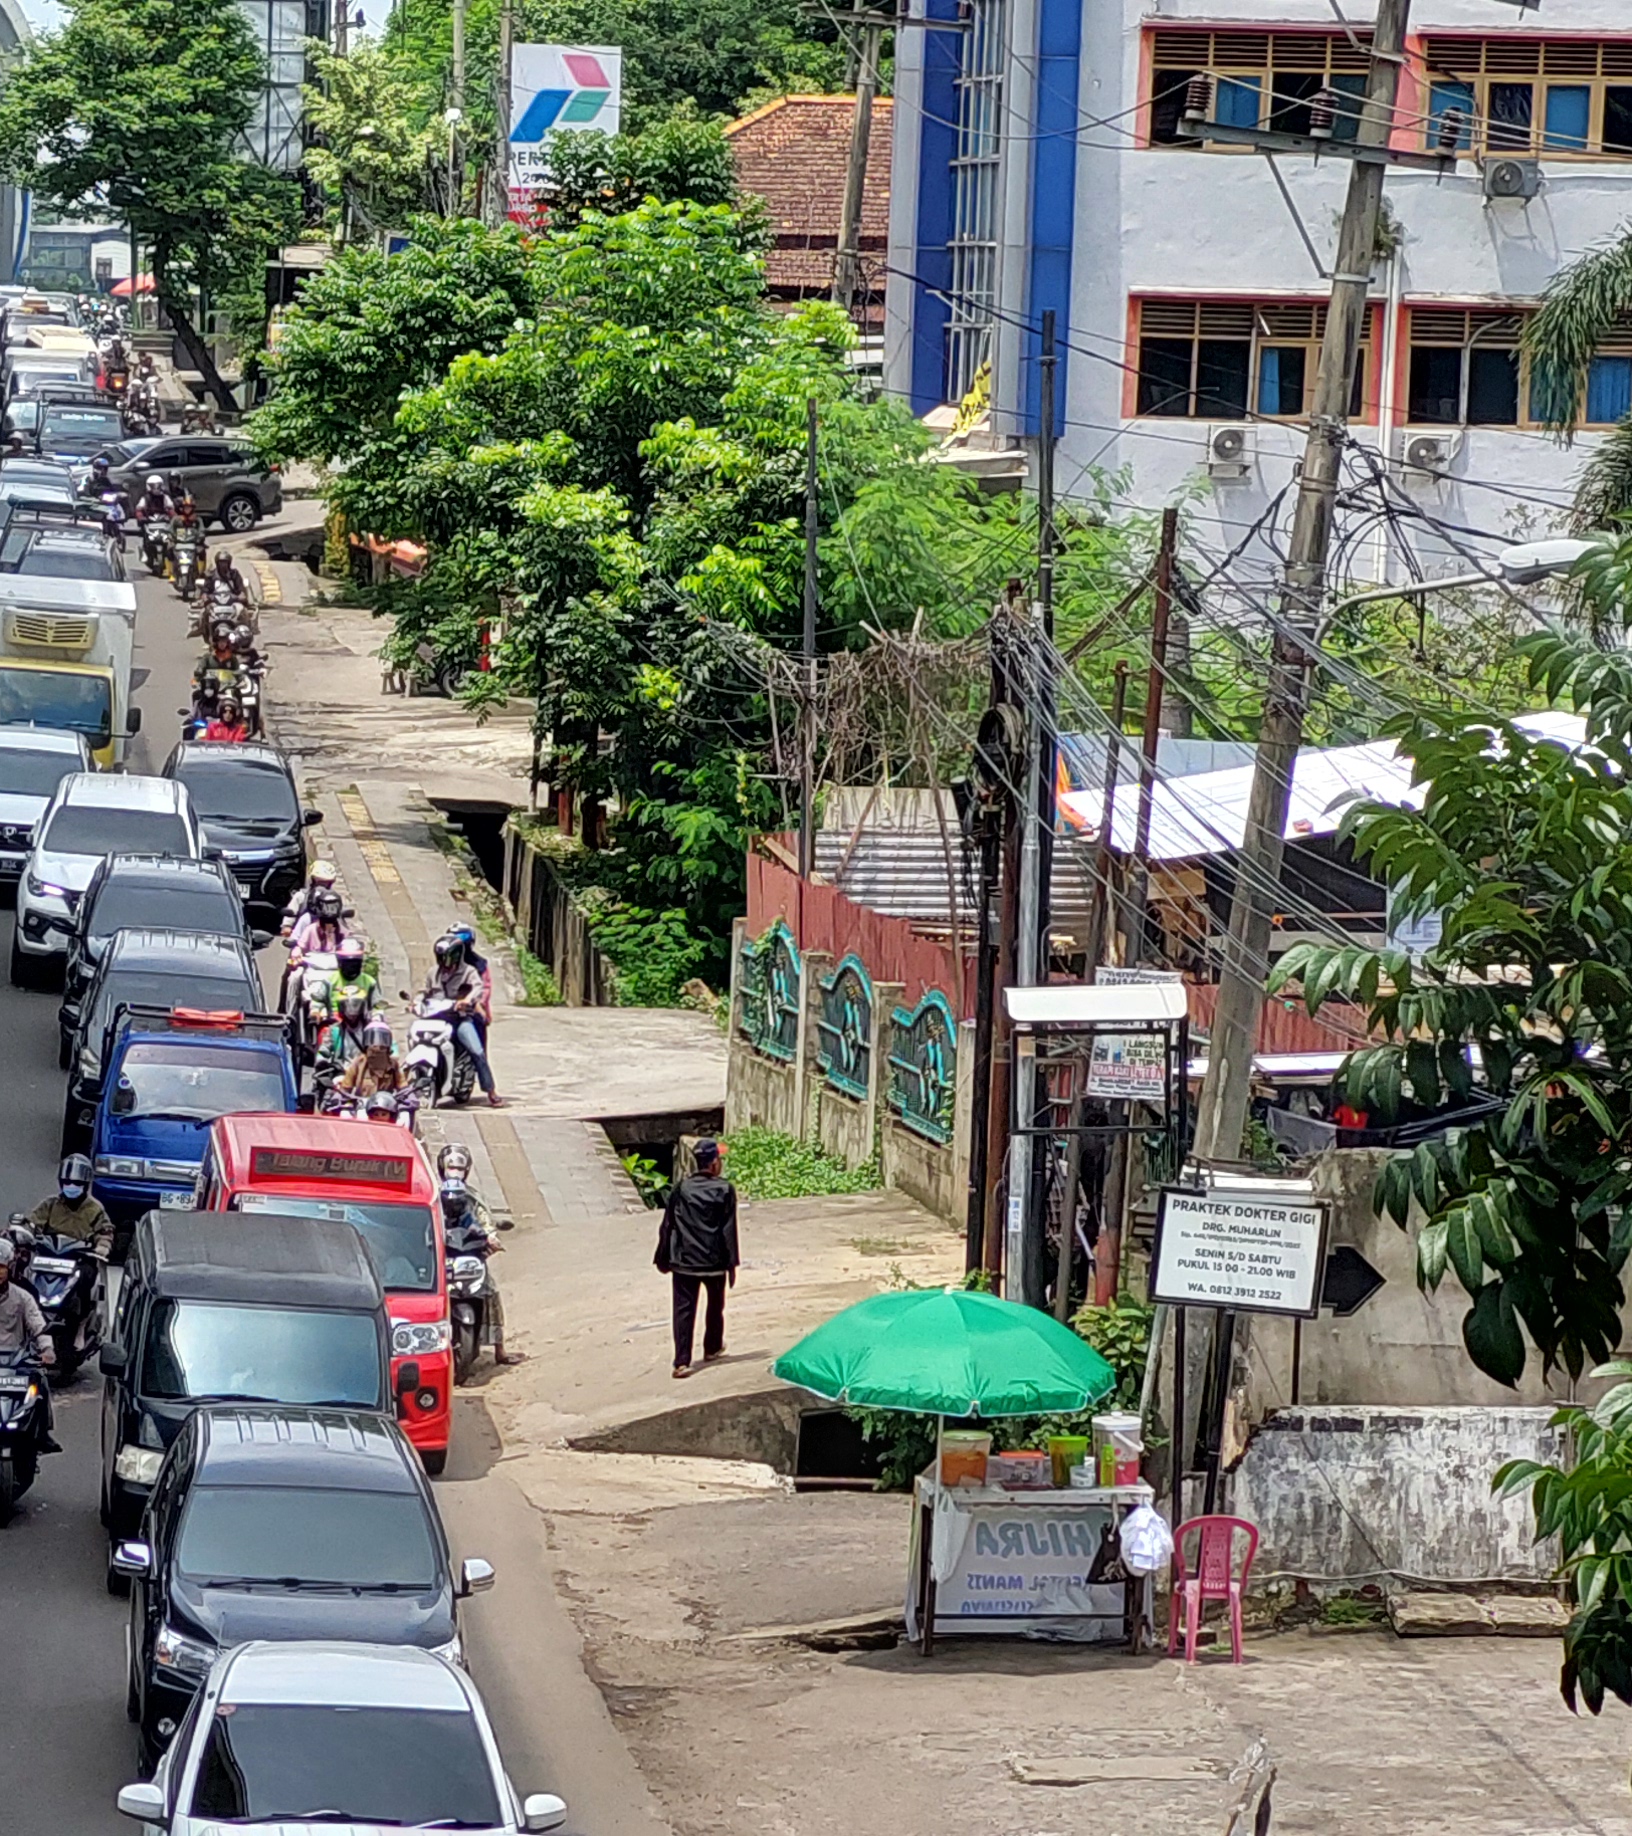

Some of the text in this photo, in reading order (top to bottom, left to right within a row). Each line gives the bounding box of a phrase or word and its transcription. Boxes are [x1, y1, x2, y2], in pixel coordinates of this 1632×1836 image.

[1172, 1199, 1316, 1225] PRAKTEK DOKTER GIGI
[1202, 1222, 1226, 1233] DRG.
[1194, 1247, 1282, 1265] SENIN S/D SABTU
[1177, 1258, 1210, 1271] PUKUL
[1276, 1268, 1296, 1279] WIB
[1187, 1282, 1206, 1293] WA.
[1234, 1286, 1256, 1298] 3912
